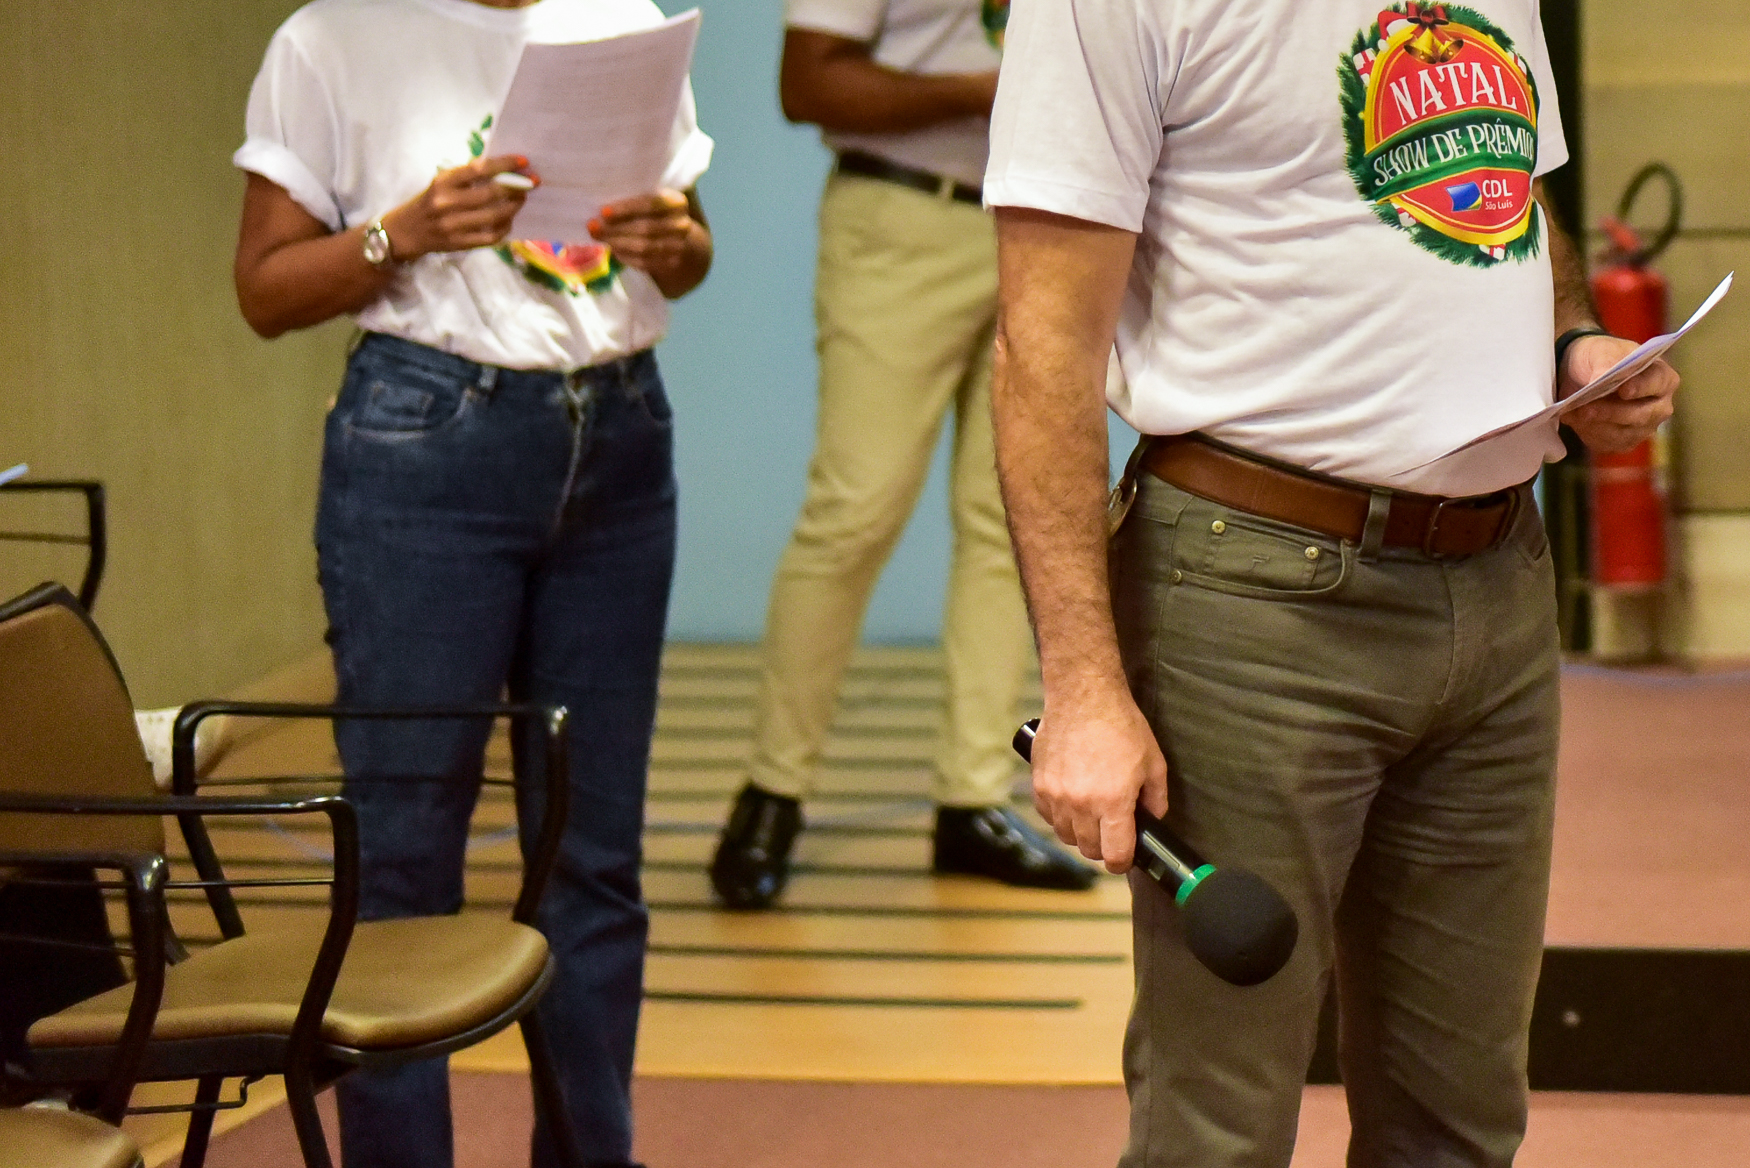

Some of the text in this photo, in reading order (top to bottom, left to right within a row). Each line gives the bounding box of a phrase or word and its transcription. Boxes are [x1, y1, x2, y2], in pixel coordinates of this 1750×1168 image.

[1389, 61, 1518, 126] NATAL
[1373, 137, 1430, 186] SHOW
[1431, 128, 1467, 163] DE
[1482, 179, 1512, 198] CDL
[1485, 200, 1496, 210] São
